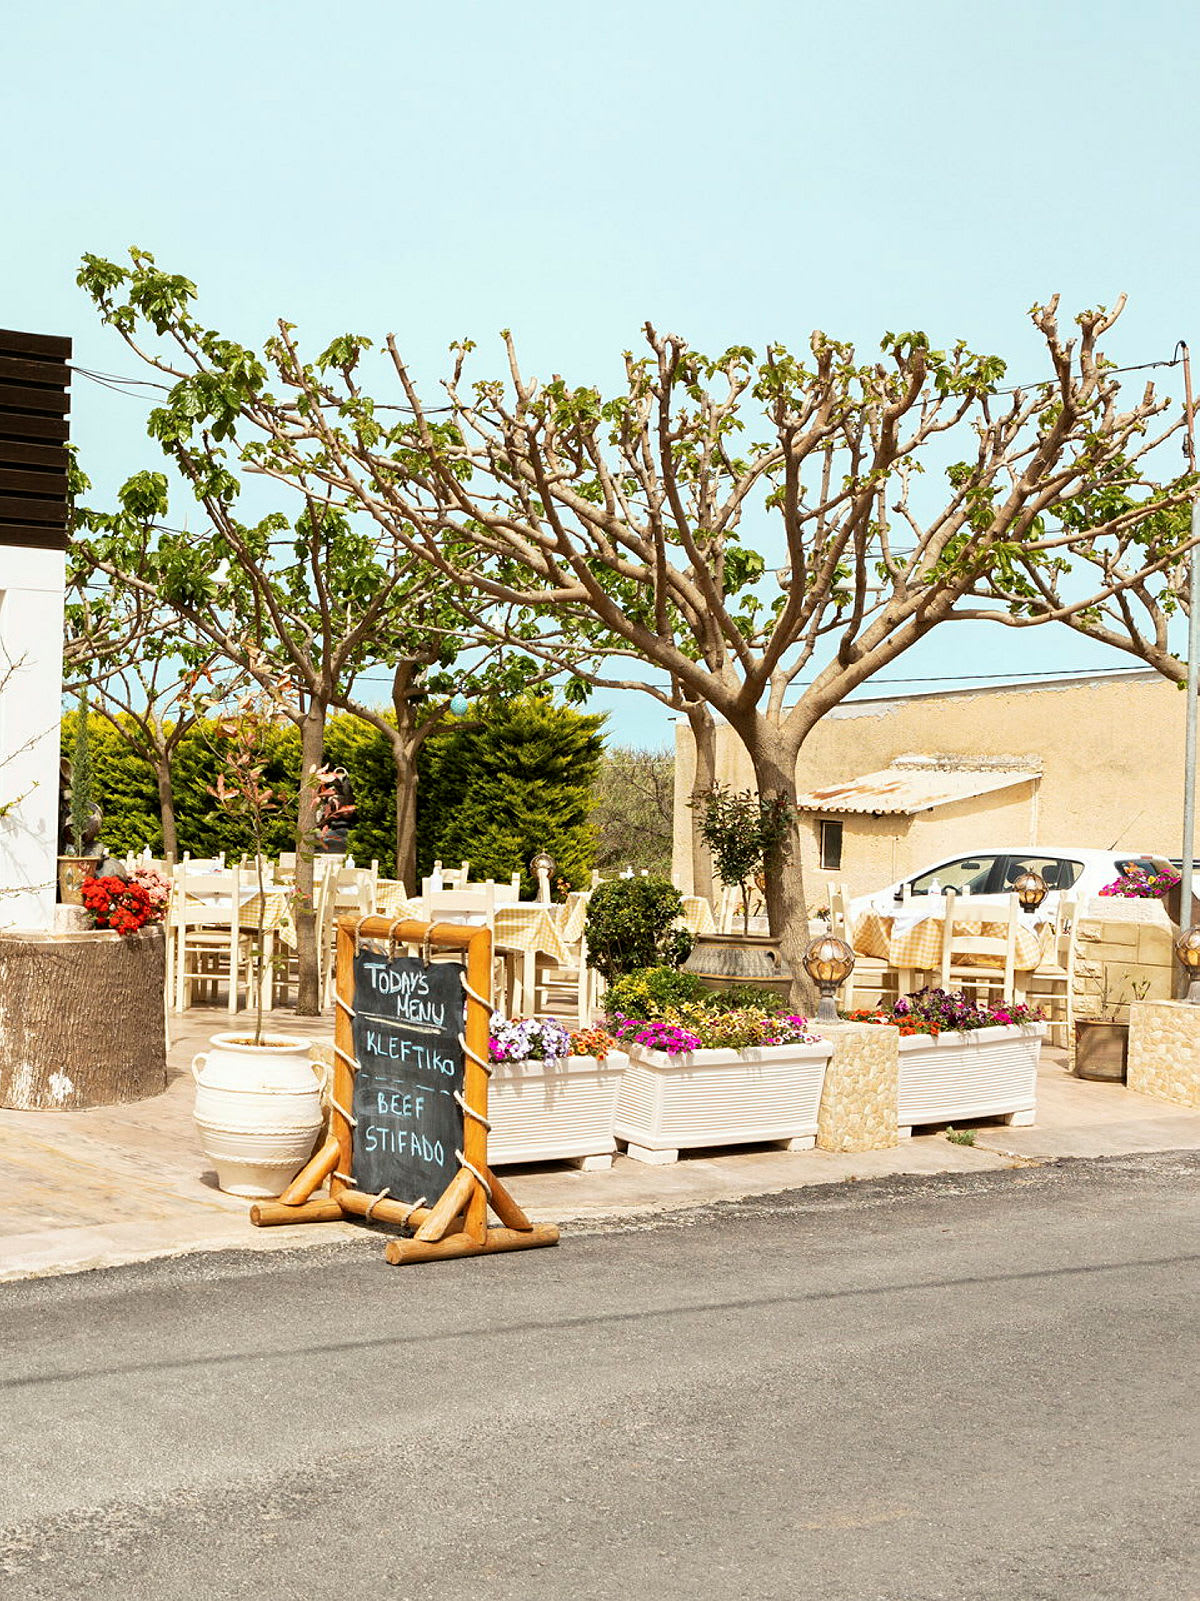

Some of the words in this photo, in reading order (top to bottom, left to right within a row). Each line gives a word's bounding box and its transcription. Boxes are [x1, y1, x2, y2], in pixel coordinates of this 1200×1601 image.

[397, 994, 445, 1025] MENU
[377, 1091, 425, 1119] BEEF
[365, 1125, 444, 1168] STIFADO
